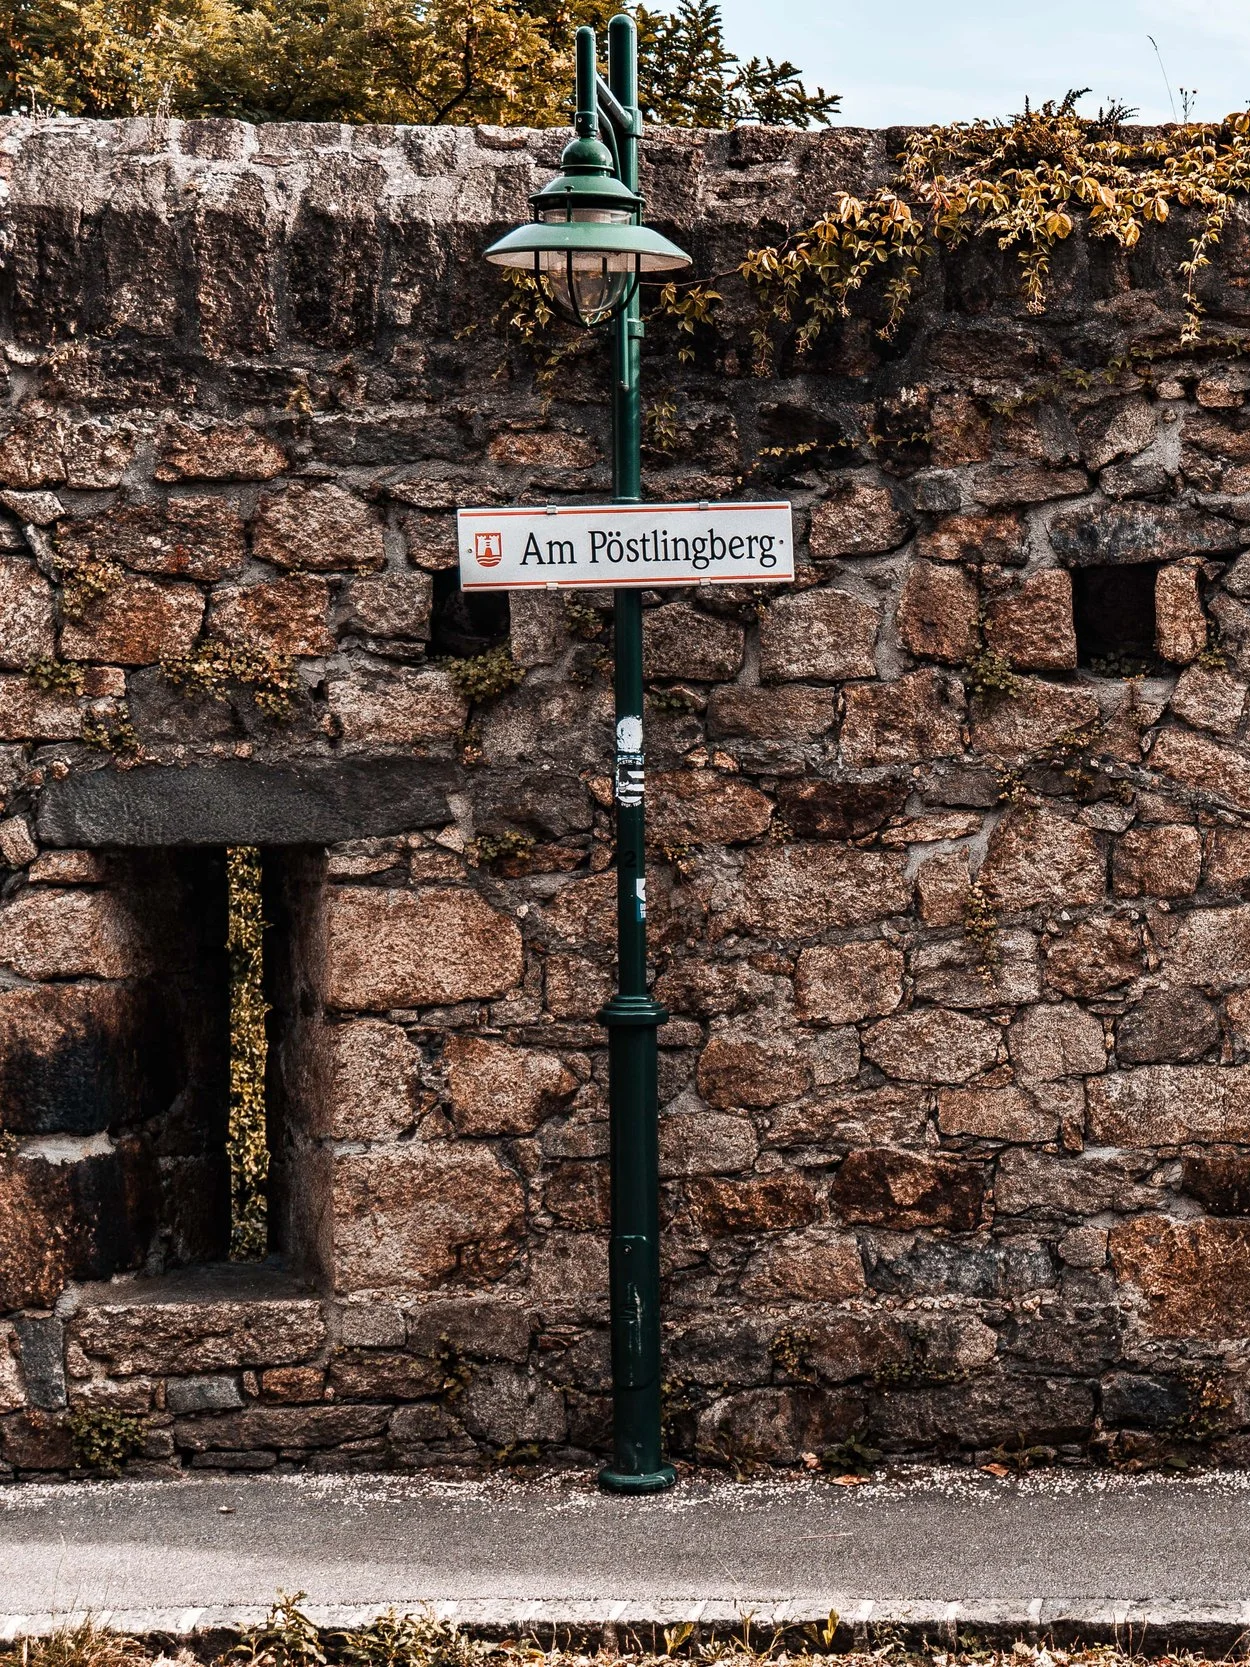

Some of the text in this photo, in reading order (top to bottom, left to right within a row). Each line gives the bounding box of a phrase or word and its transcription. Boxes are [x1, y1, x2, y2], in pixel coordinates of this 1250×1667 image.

[520, 528, 777, 569] Am Pöstlingberg
[624, 850, 637, 868] 2
